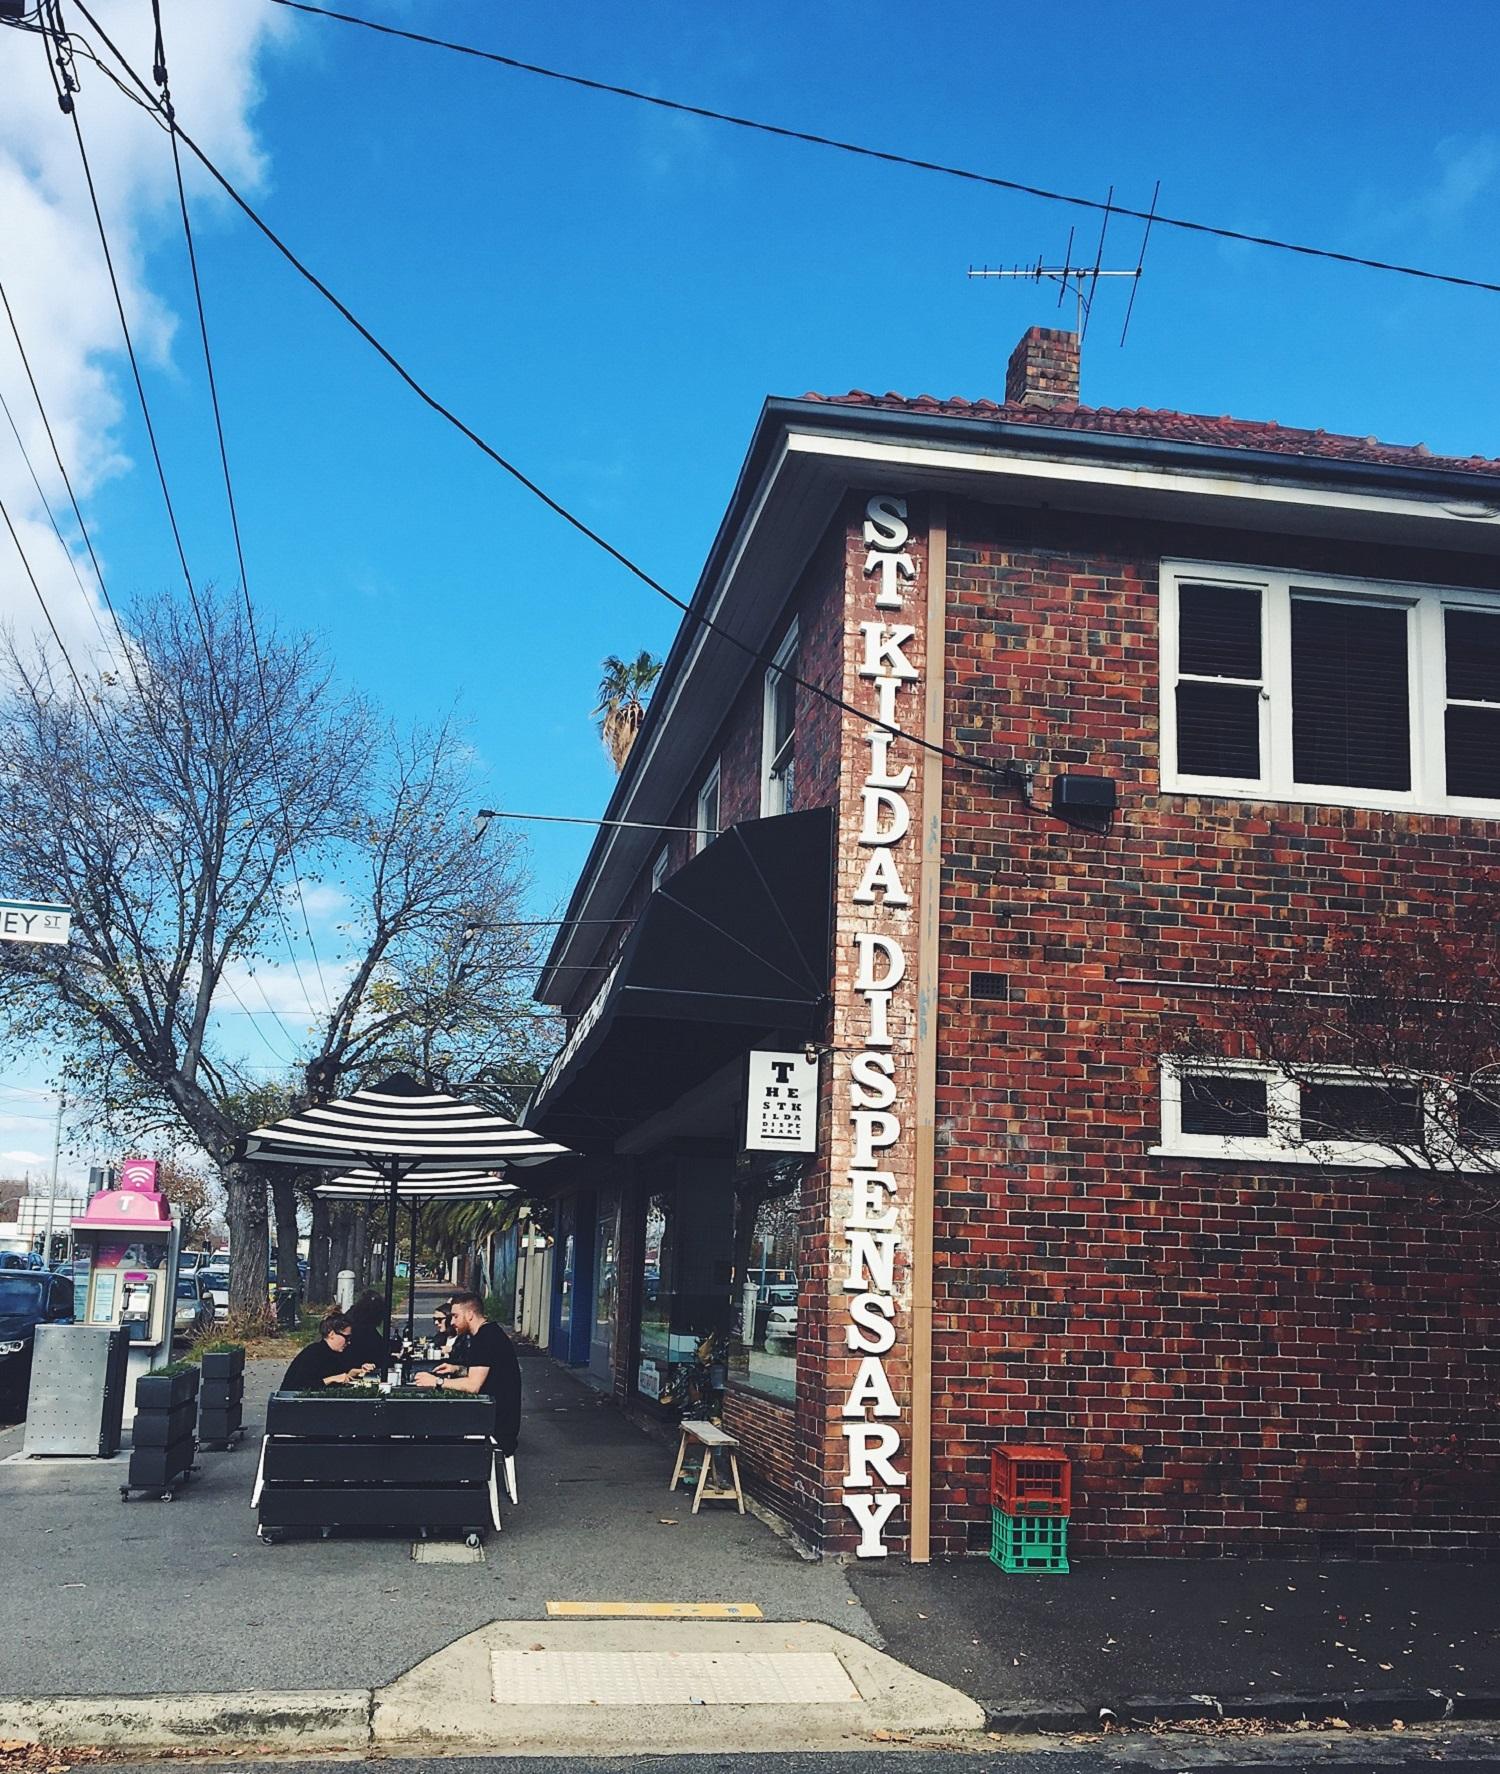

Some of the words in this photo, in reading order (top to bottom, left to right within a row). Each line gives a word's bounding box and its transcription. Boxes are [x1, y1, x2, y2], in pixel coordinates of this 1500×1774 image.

[863, 495, 915, 607] ST
[853, 621, 920, 905] KILDA
[0, 911, 38, 934] EY
[44, 915, 62, 927] ST
[766, 1087, 799, 1098] HE
[771, 1061, 795, 1084] T
[842, 932, 907, 1557] DISPENSARY
